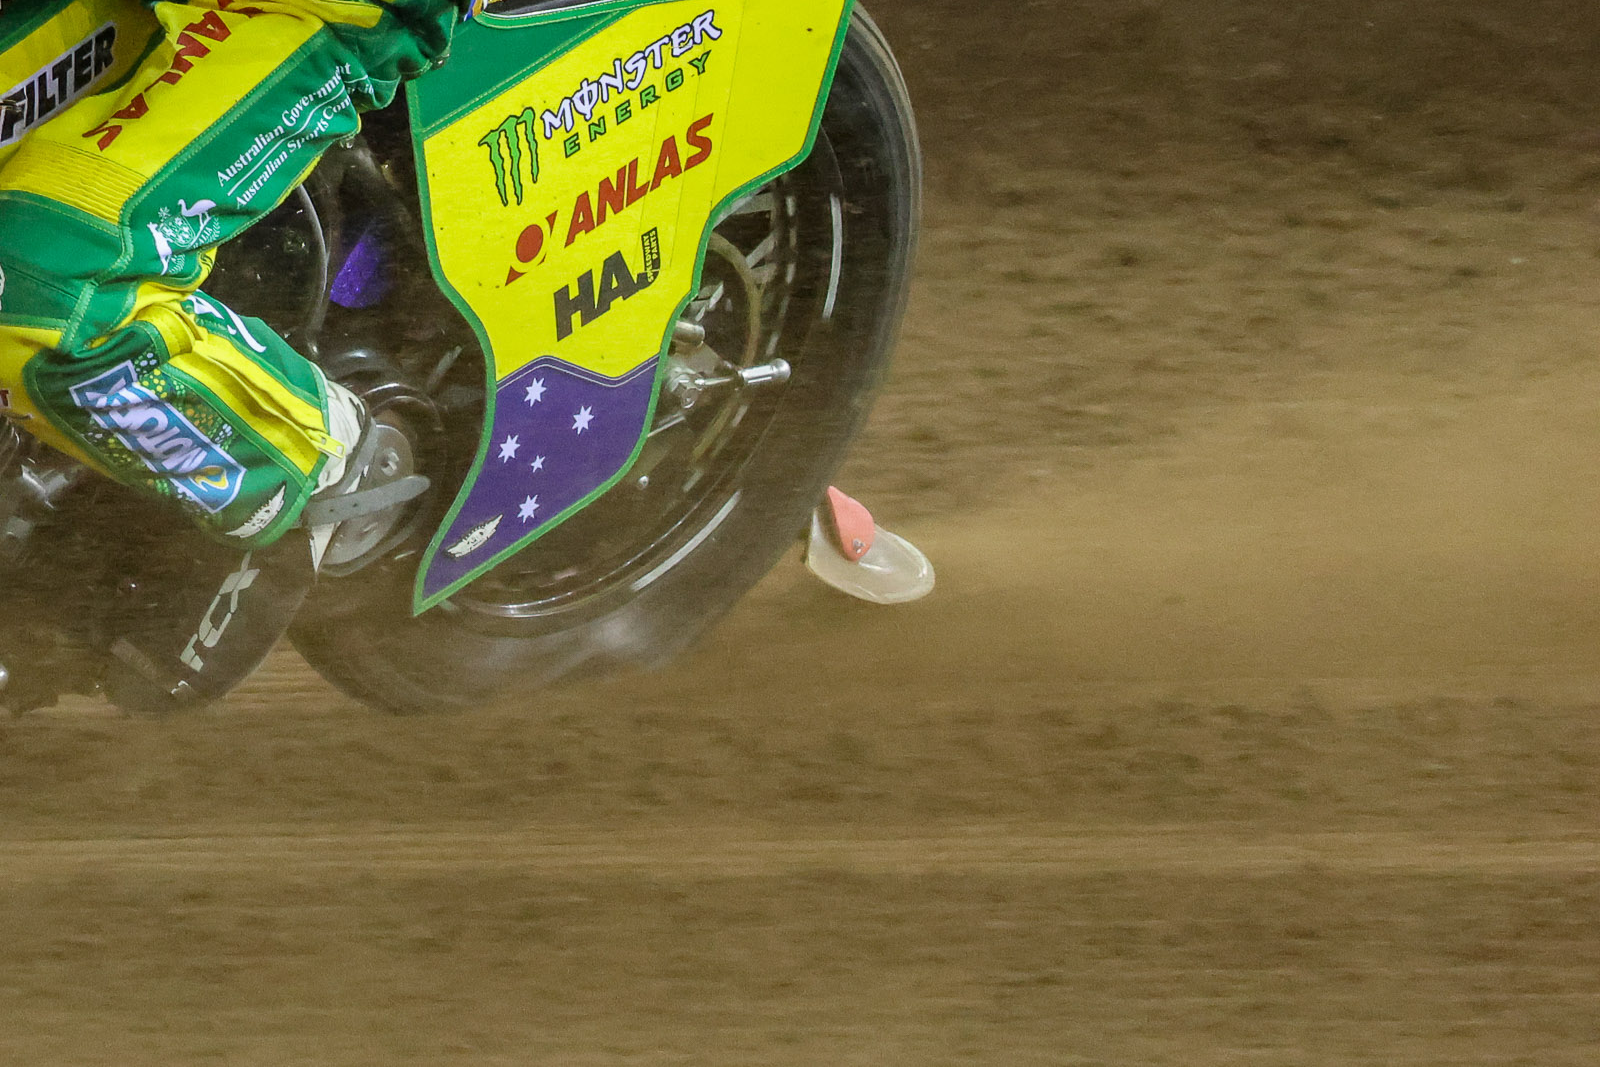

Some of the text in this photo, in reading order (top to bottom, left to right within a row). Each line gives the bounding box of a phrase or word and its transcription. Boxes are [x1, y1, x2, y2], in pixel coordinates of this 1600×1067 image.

[540, 9, 723, 140] MONSTER
[563, 49, 712, 159] ENERGY
[216, 124, 285, 188] Australian
[235, 149, 289, 210] Australian
[564, 112, 714, 249] ANLAS
